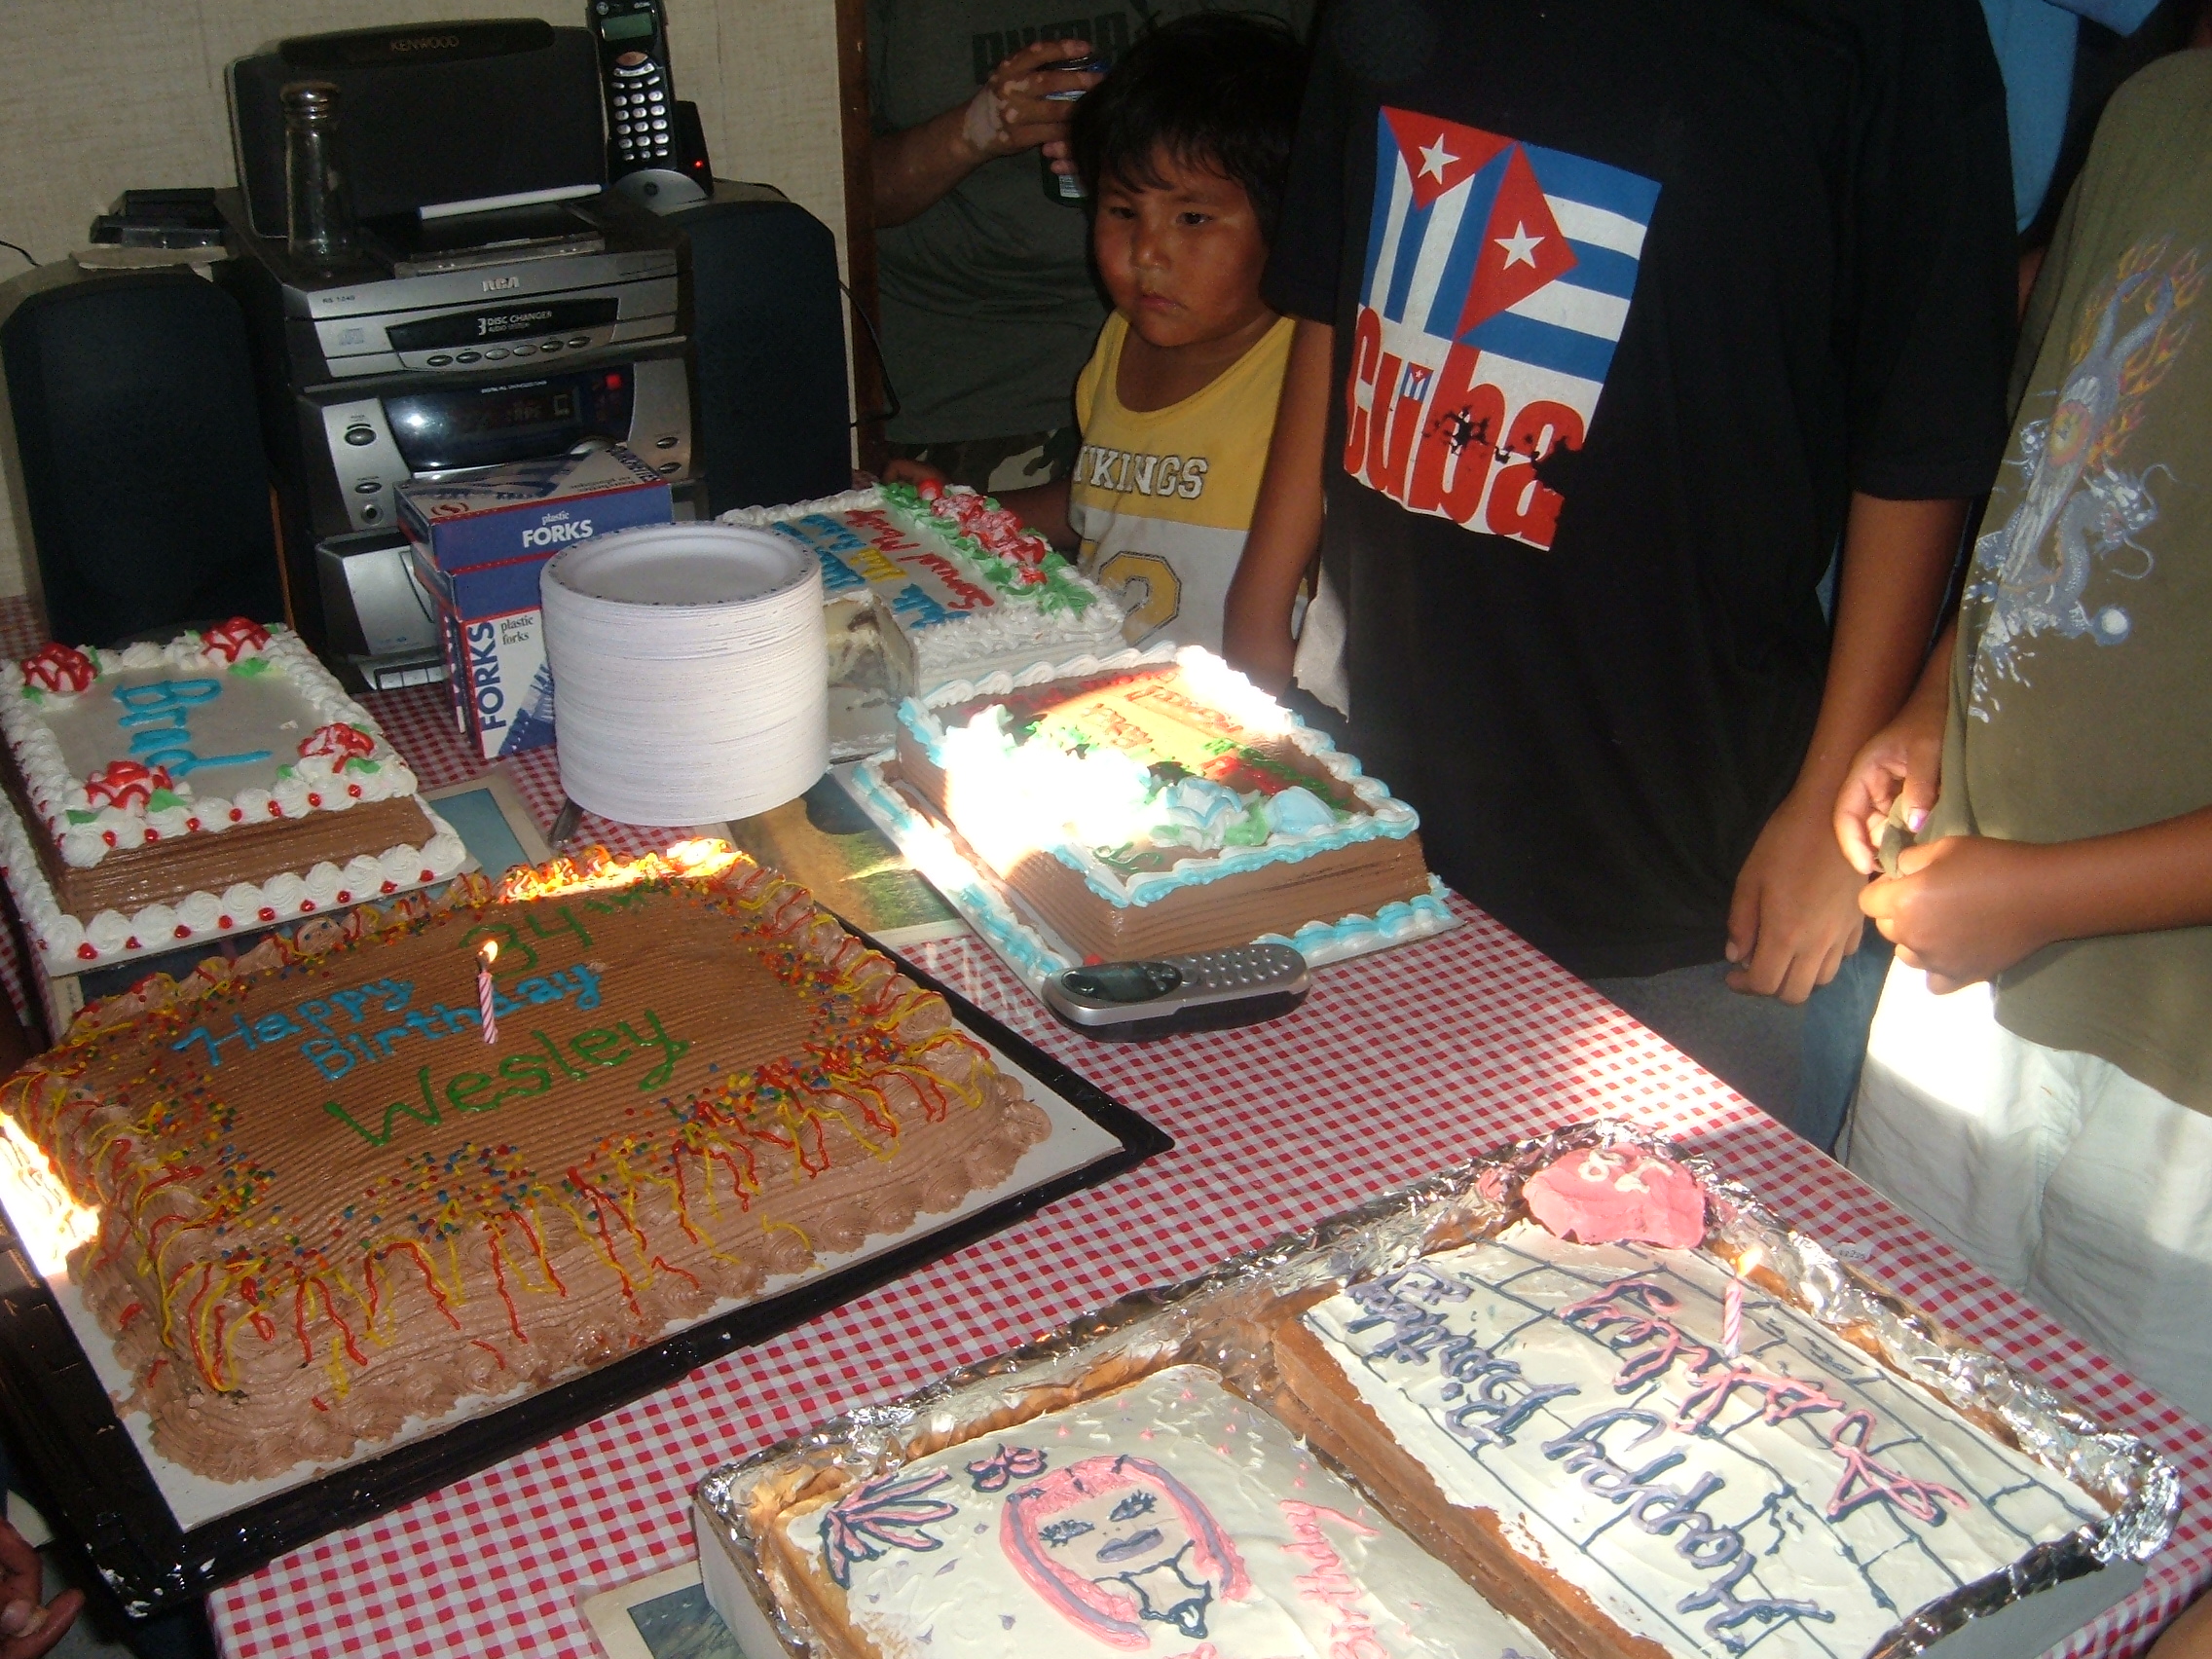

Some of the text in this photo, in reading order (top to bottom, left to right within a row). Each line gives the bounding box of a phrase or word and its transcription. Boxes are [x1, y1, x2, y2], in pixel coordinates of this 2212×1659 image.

[390, 36, 459, 52] KENWOOD
[482, 276, 520, 292] RCA
[477, 311, 553, 336] 3 DISC CHANGER
[541, 510, 570, 526] plastic
[522, 519, 593, 548] FORKS
[500, 615, 535, 632] plastic
[502, 632, 530, 645] forks
[467, 621, 507, 732] FORKS
[171, 977, 415, 1067] Happy
[301, 963, 602, 1081] Birthday
[323, 1009, 689, 1148] Wesley
[1560, 1278, 1972, 1527] Ashley
[1344, 1263, 1836, 1655] Happy Birthday
